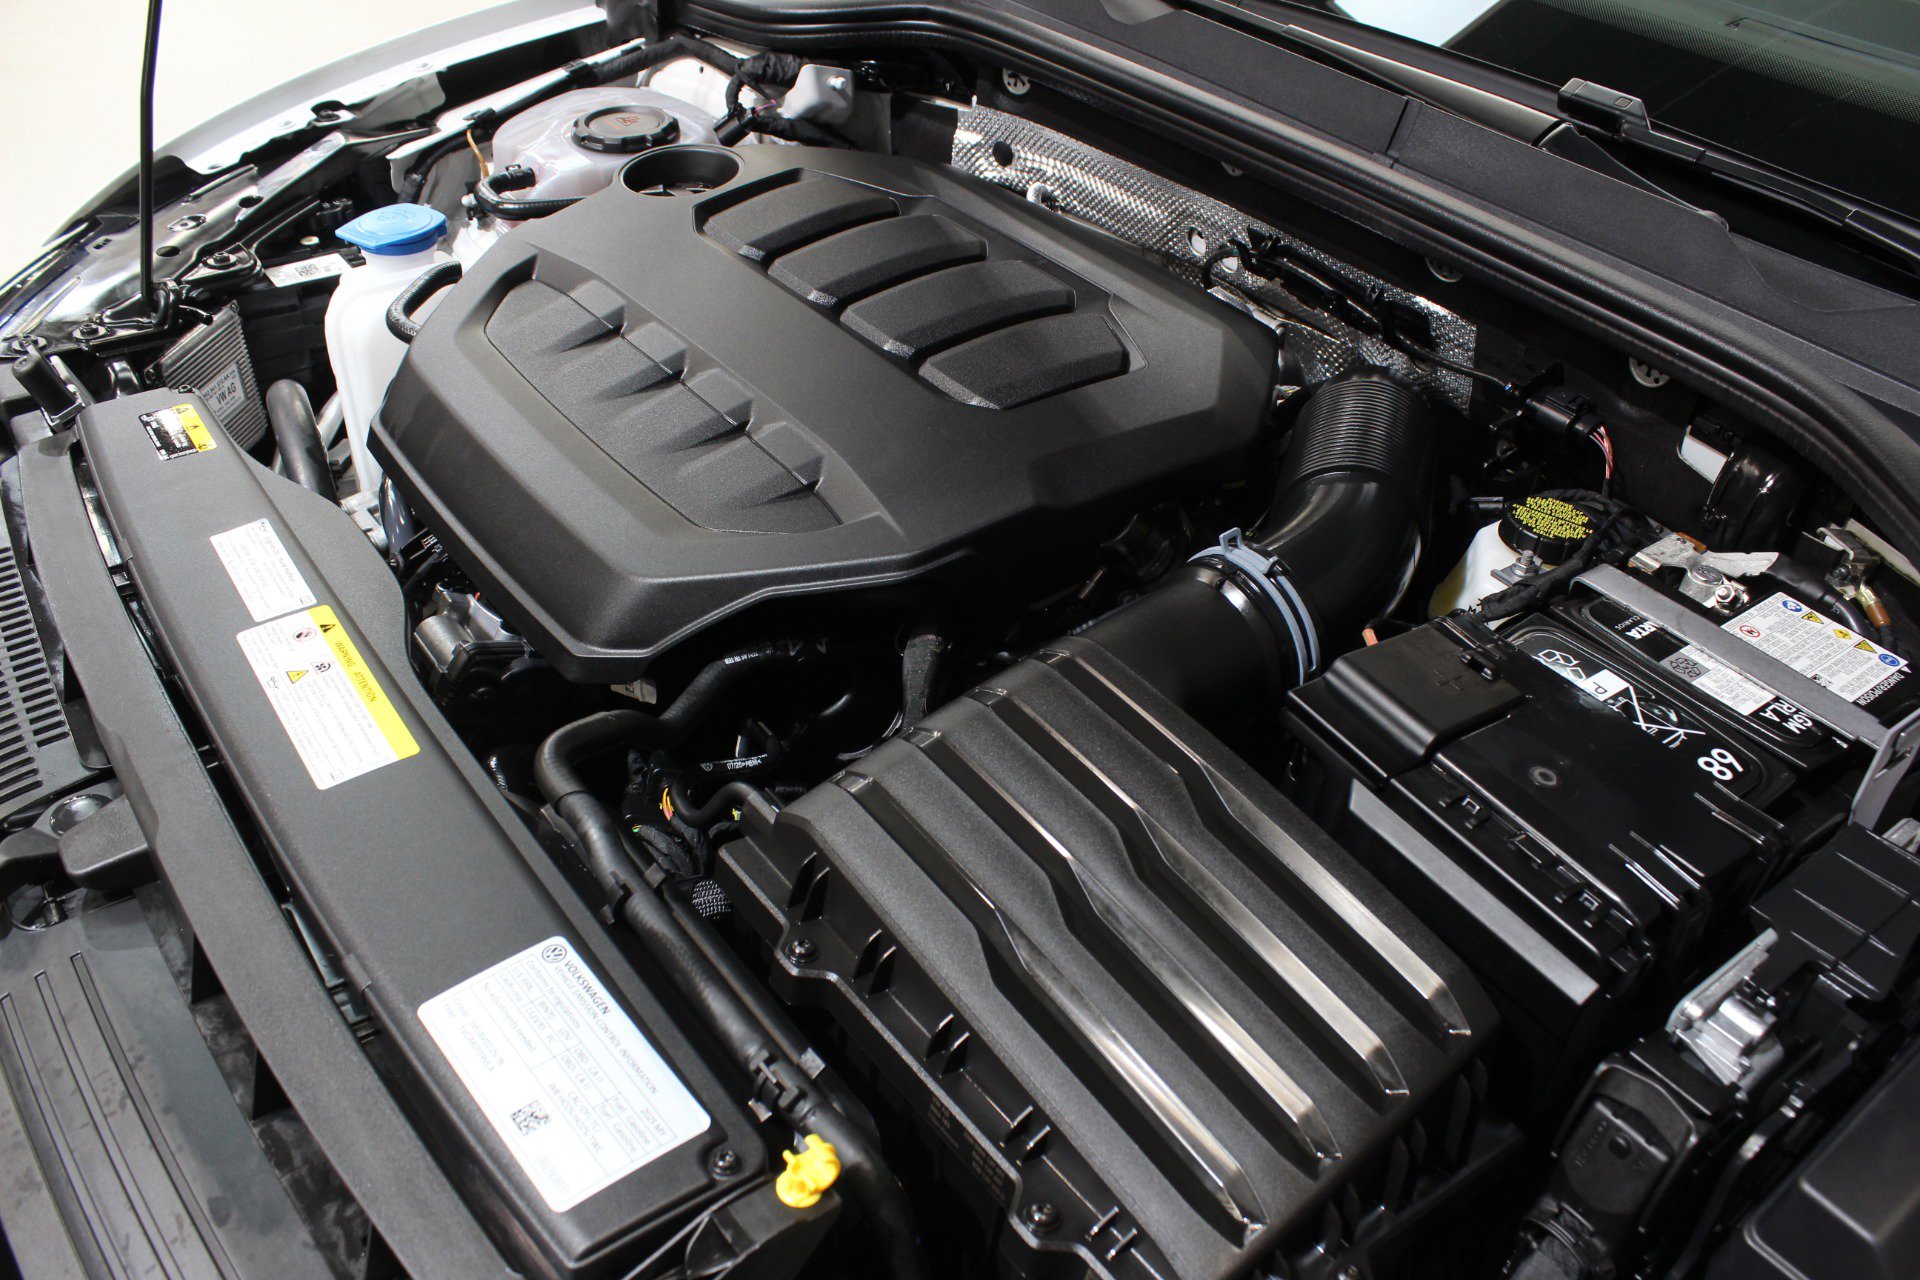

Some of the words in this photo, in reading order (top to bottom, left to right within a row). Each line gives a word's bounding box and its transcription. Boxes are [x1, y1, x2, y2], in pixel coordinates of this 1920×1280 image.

[216, 390, 226, 404] VW
[227, 382, 236, 395] AG
[333, 640, 355, 667] WARNING
[352, 669, 377, 702] ATTENTION
[1857, 672, 1904, 706] DANGER/POISON
[1698, 748, 1744, 781] 68
[562, 959, 612, 1015] VOLKSWAGEN
[552, 965, 575, 990] VEHICLE
[571, 989, 599, 1019] EMISSION
[594, 1017, 622, 1048] CONTROL
[618, 1047, 658, 1094] INFORMATION
[610, 1121, 640, 1153] Gasoline
[624, 1114, 653, 1146] Gasoline
